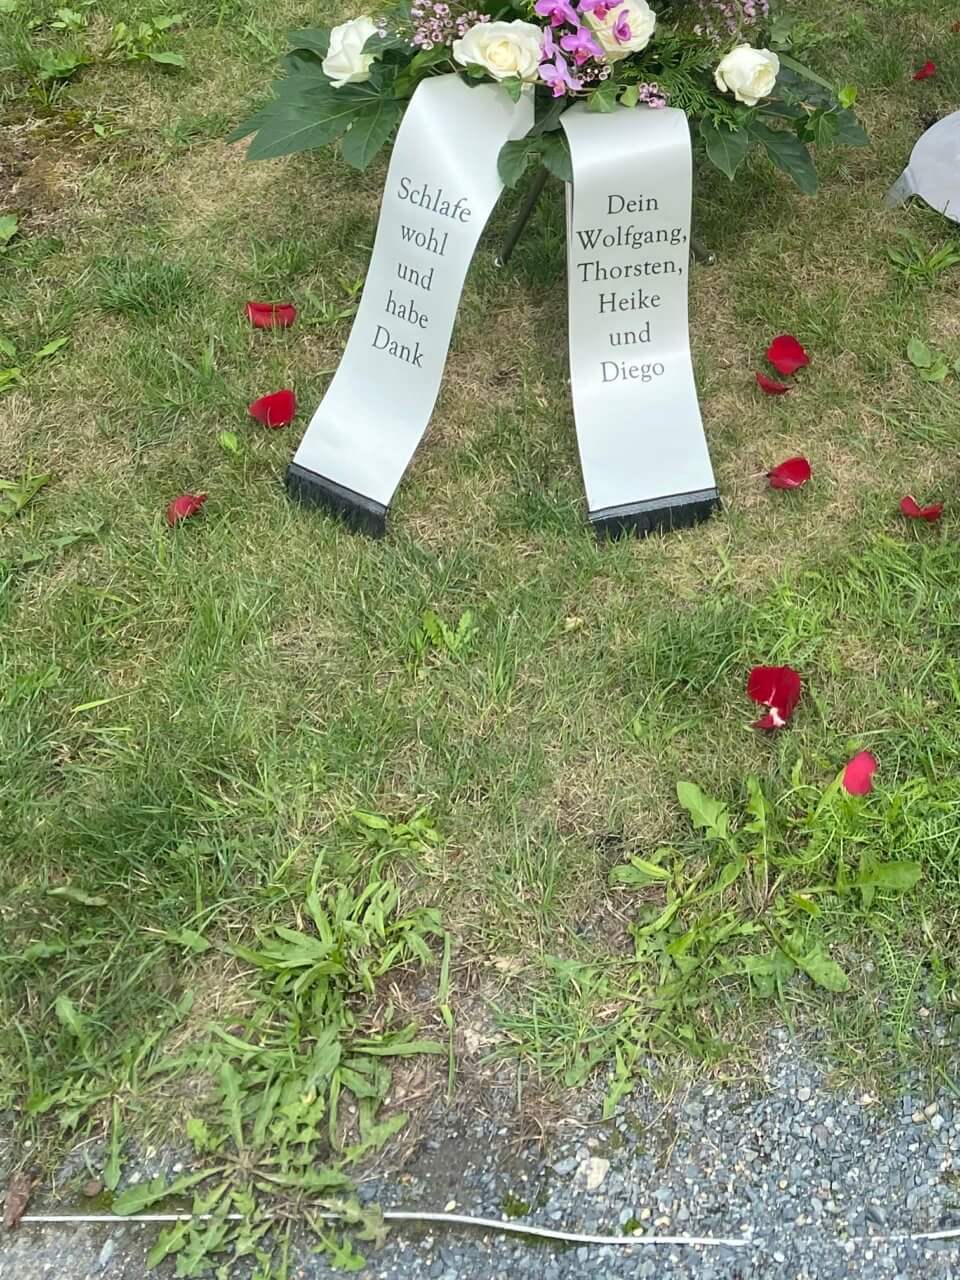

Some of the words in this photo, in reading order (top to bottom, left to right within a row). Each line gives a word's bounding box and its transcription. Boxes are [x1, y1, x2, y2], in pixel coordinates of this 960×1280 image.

[397, 177, 472, 223] Schlafe
[606, 193, 660, 216] Dein
[400, 224, 449, 257] wohl
[577, 224, 688, 252] Wolfgang,
[397, 262, 434, 291] und
[577, 260, 684, 284] Thorsten,
[385, 290, 430, 329] habe
[598, 291, 662, 315] Heike
[371, 325, 425, 369] Dank
[608, 322, 652, 348] und
[600, 360, 666, 384] Diego
